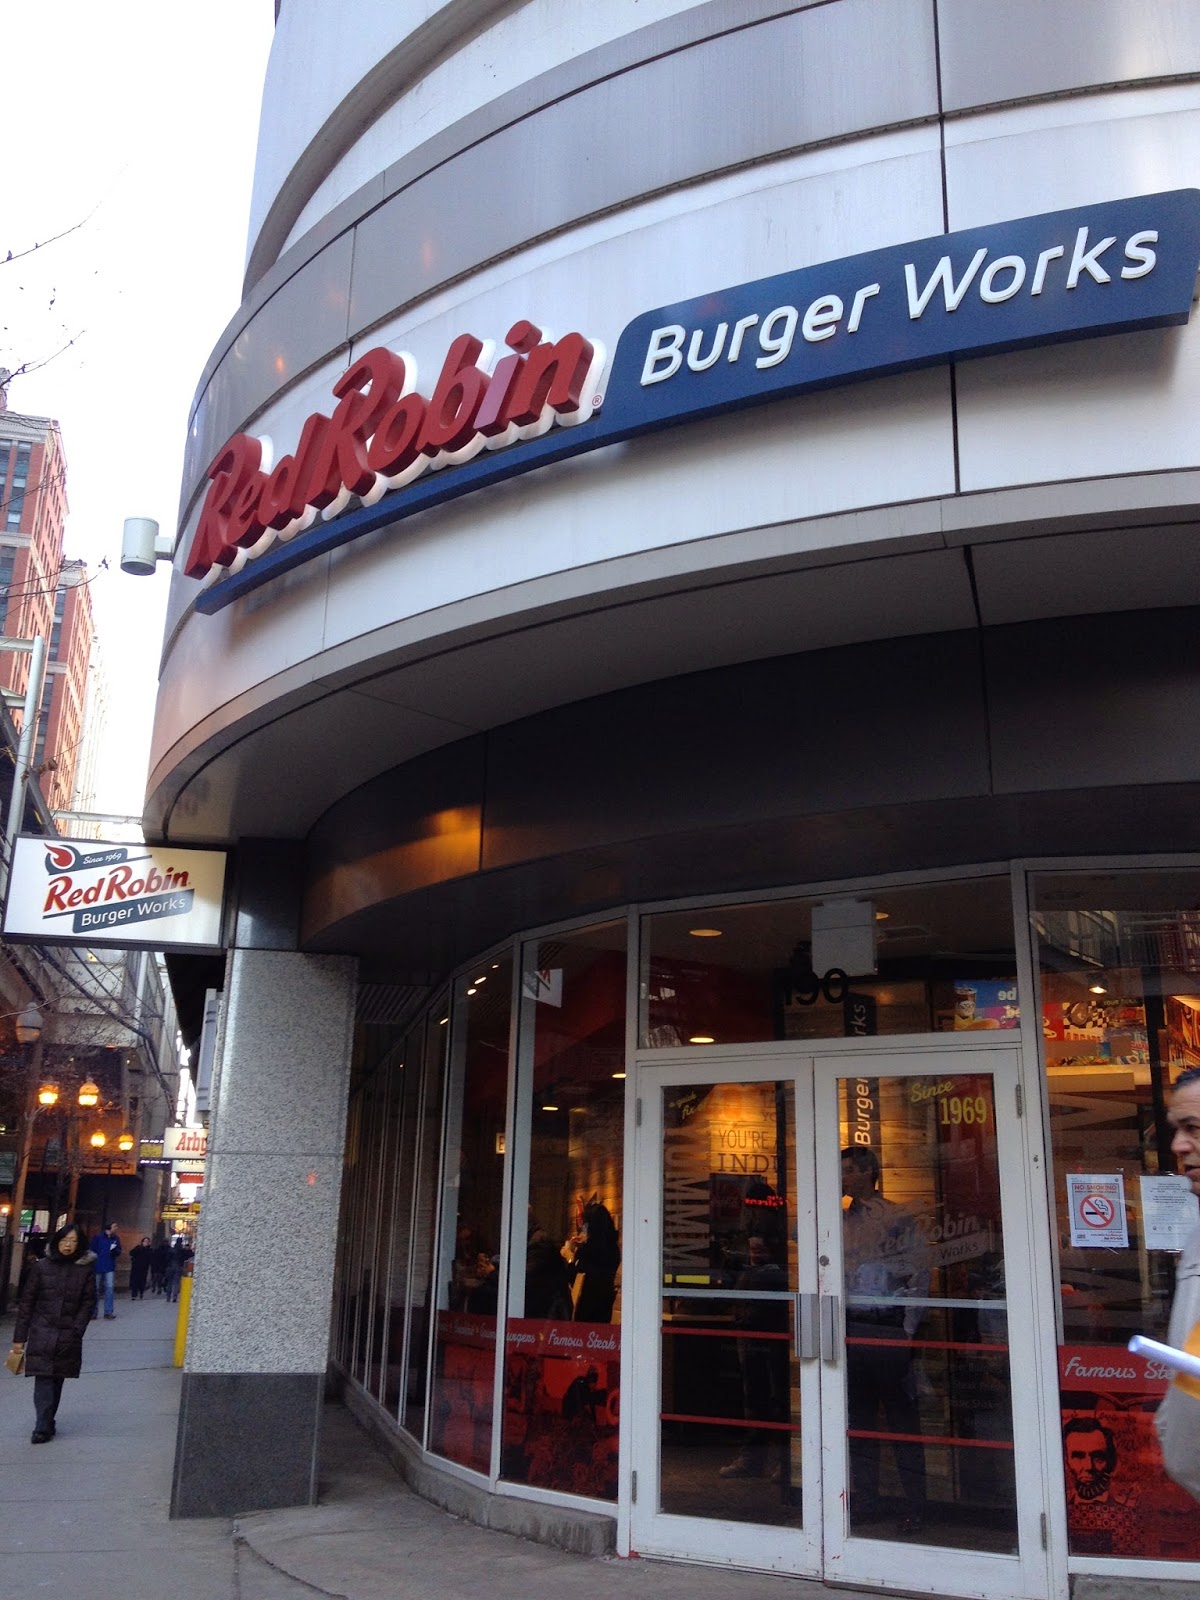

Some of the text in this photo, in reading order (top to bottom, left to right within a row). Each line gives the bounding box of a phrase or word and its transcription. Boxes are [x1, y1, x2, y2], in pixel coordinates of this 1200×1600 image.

[639, 224, 1160, 388] Burger Works
[83, 851, 123, 865] Since 1969
[81, 896, 187, 927] Burger Works
[850, 1003, 867, 1036] rks
[911, 1080, 955, 1104] Since
[940, 1096, 987, 1125] 1969
[718, 1130, 769, 1150] YOU'RE
[506, 1332, 536, 1349] urgers
[548, 1328, 617, 1350] Famous Steak
[1064, 1356, 1175, 1380] Famous Ste
